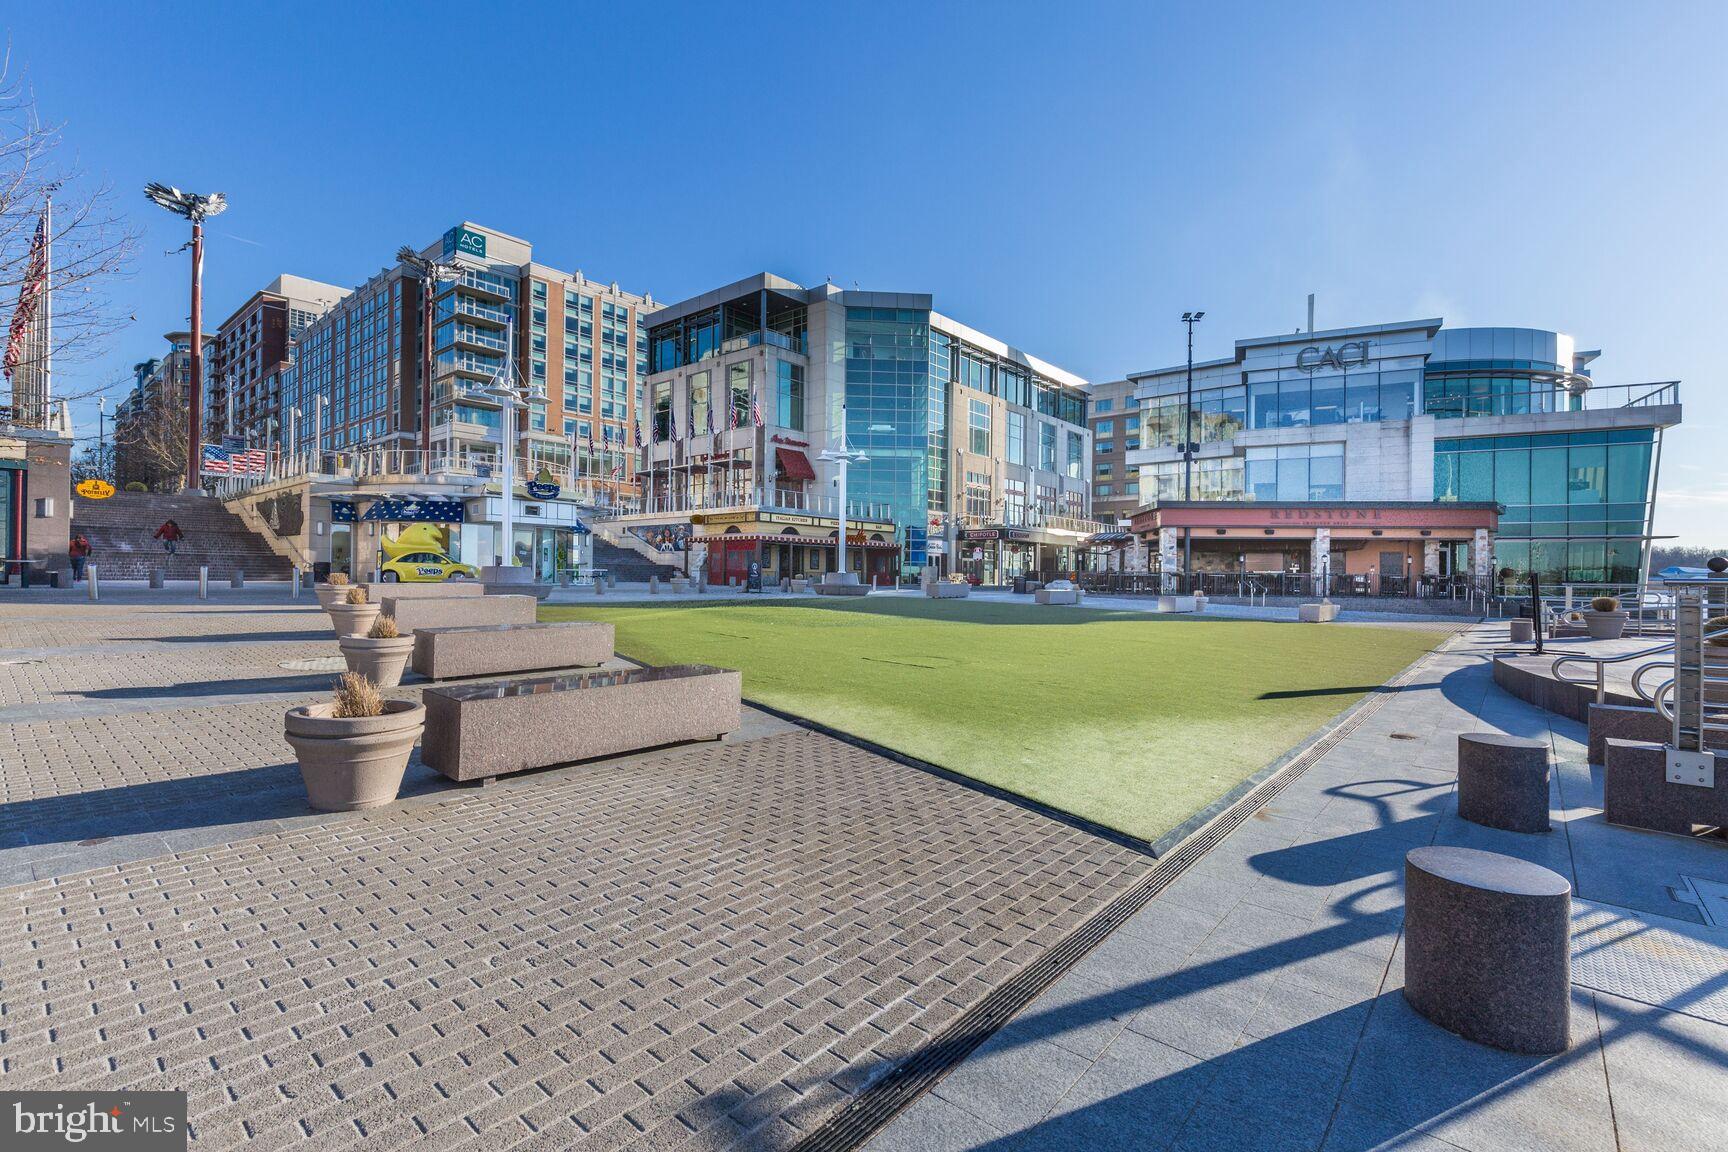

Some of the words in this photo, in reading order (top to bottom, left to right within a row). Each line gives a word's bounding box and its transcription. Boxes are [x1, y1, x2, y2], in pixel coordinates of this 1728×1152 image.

[460, 233, 483, 248] AC
[460, 243, 483, 254] HOTELS
[1297, 341, 1370, 373] CACI
[526, 481, 560, 493] Peeps
[1270, 509, 1382, 520] REDSTONE
[416, 566, 443, 577] Peeps
